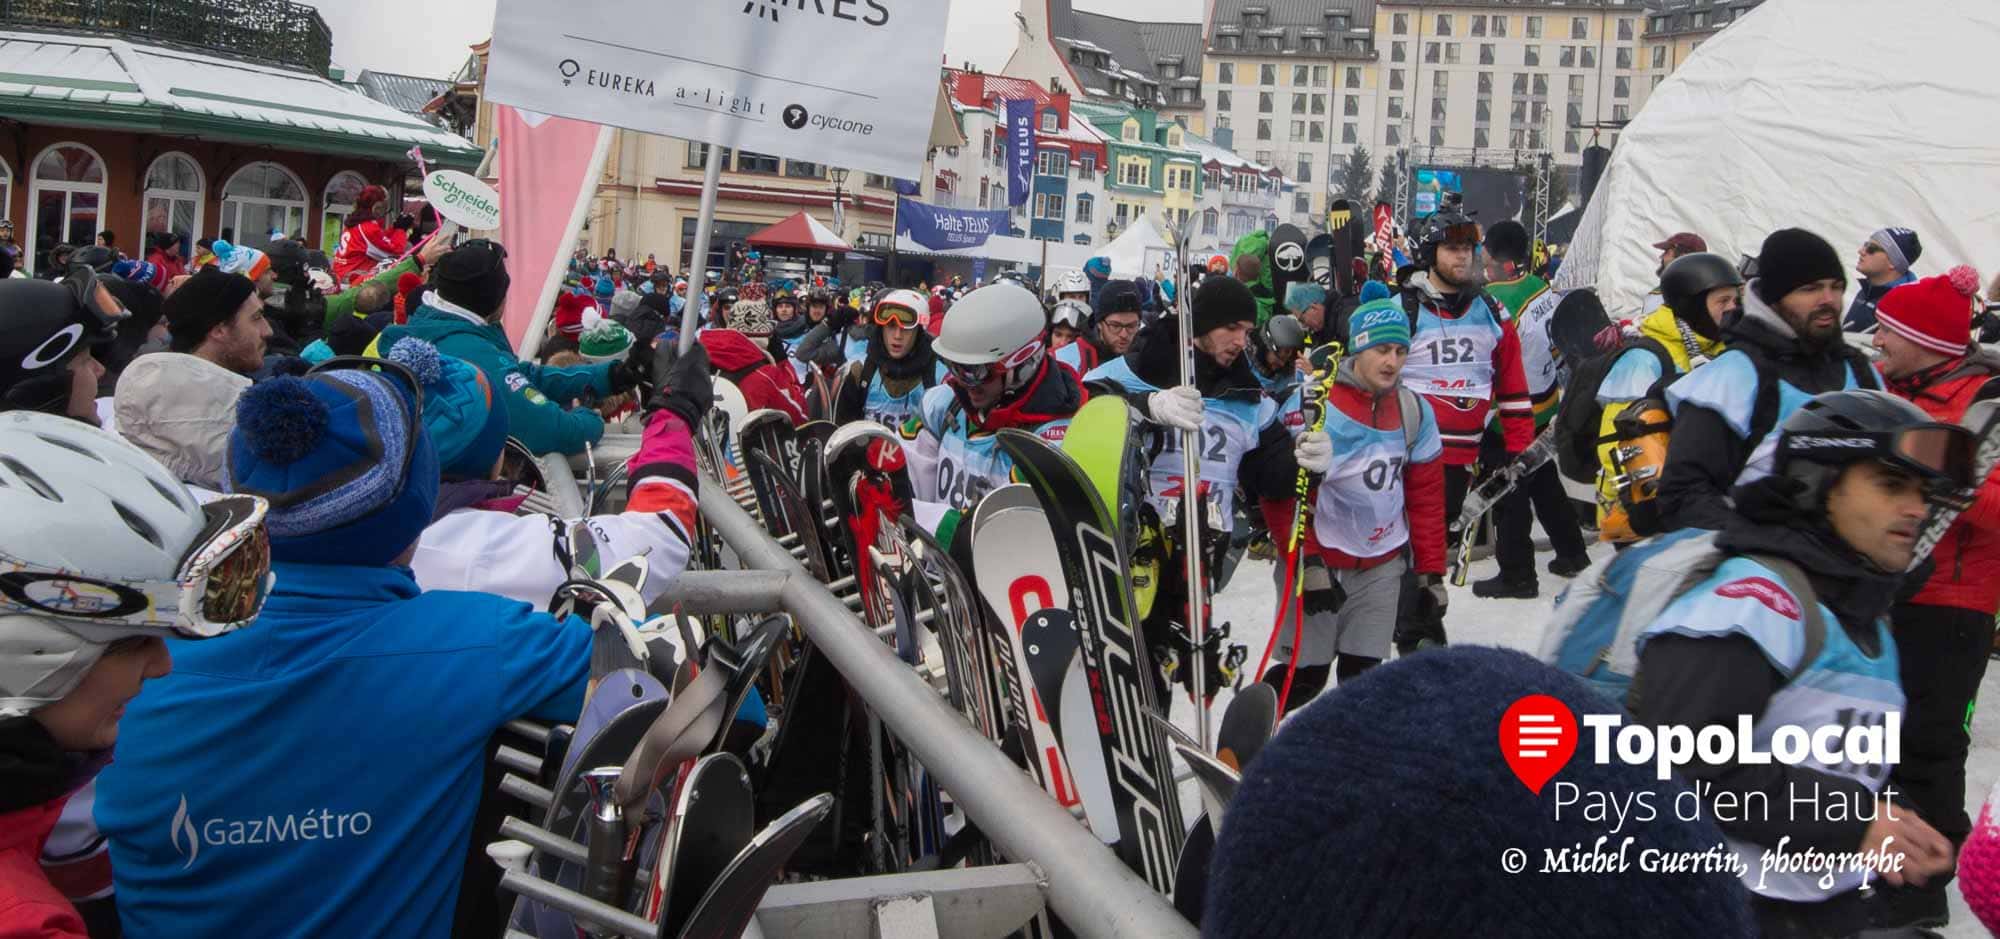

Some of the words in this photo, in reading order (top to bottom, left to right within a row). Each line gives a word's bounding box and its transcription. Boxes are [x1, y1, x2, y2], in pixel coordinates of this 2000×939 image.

[587, 69, 656, 97] EUREKA
[1018, 116, 1030, 165] TELUS
[432, 174, 499, 217] Schneider
[934, 211, 963, 233] Halte
[962, 215, 990, 234] TELUS
[1426, 337, 1474, 365] 152
[1811, 437, 1876, 449] SINNER
[1073, 587, 1096, 667] race
[994, 633, 1029, 730] world
[203, 808, 372, 846] GazMétro
